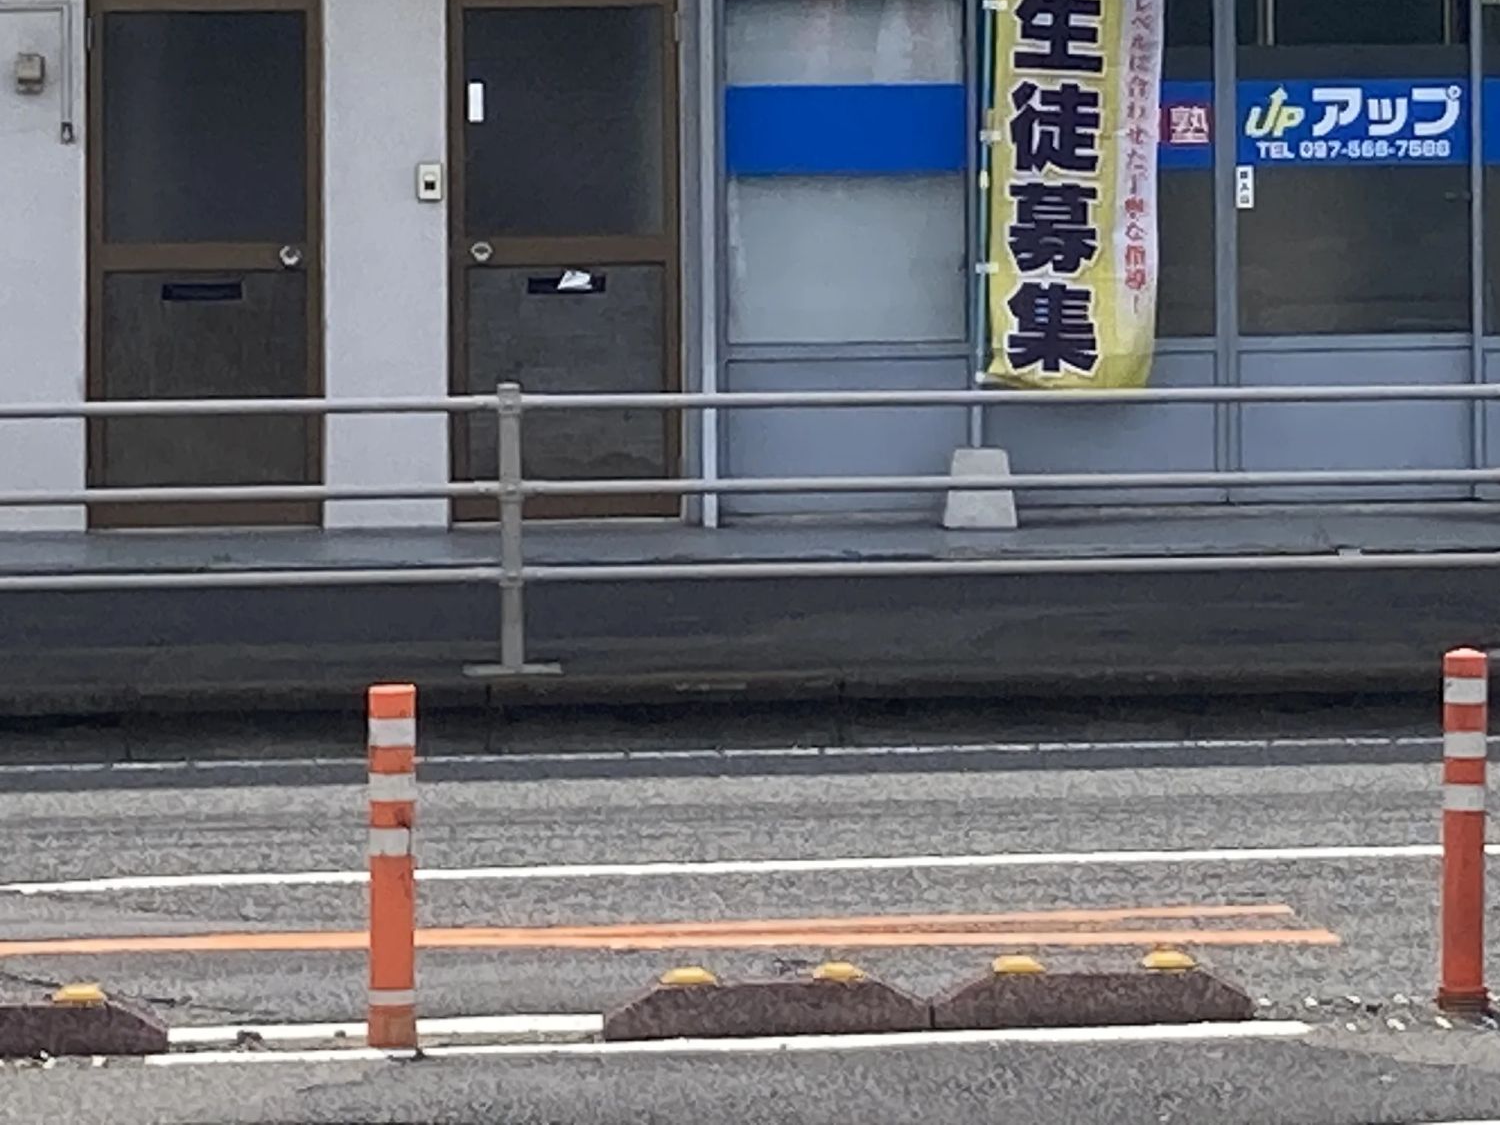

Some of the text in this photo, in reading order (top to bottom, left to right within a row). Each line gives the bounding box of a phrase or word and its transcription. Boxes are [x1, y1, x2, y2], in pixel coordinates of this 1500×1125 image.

[1169, 106, 1210, 143] 塾
[1245, 83, 1462, 138] UP アップ
[1256, 141, 1296, 159] TEL
